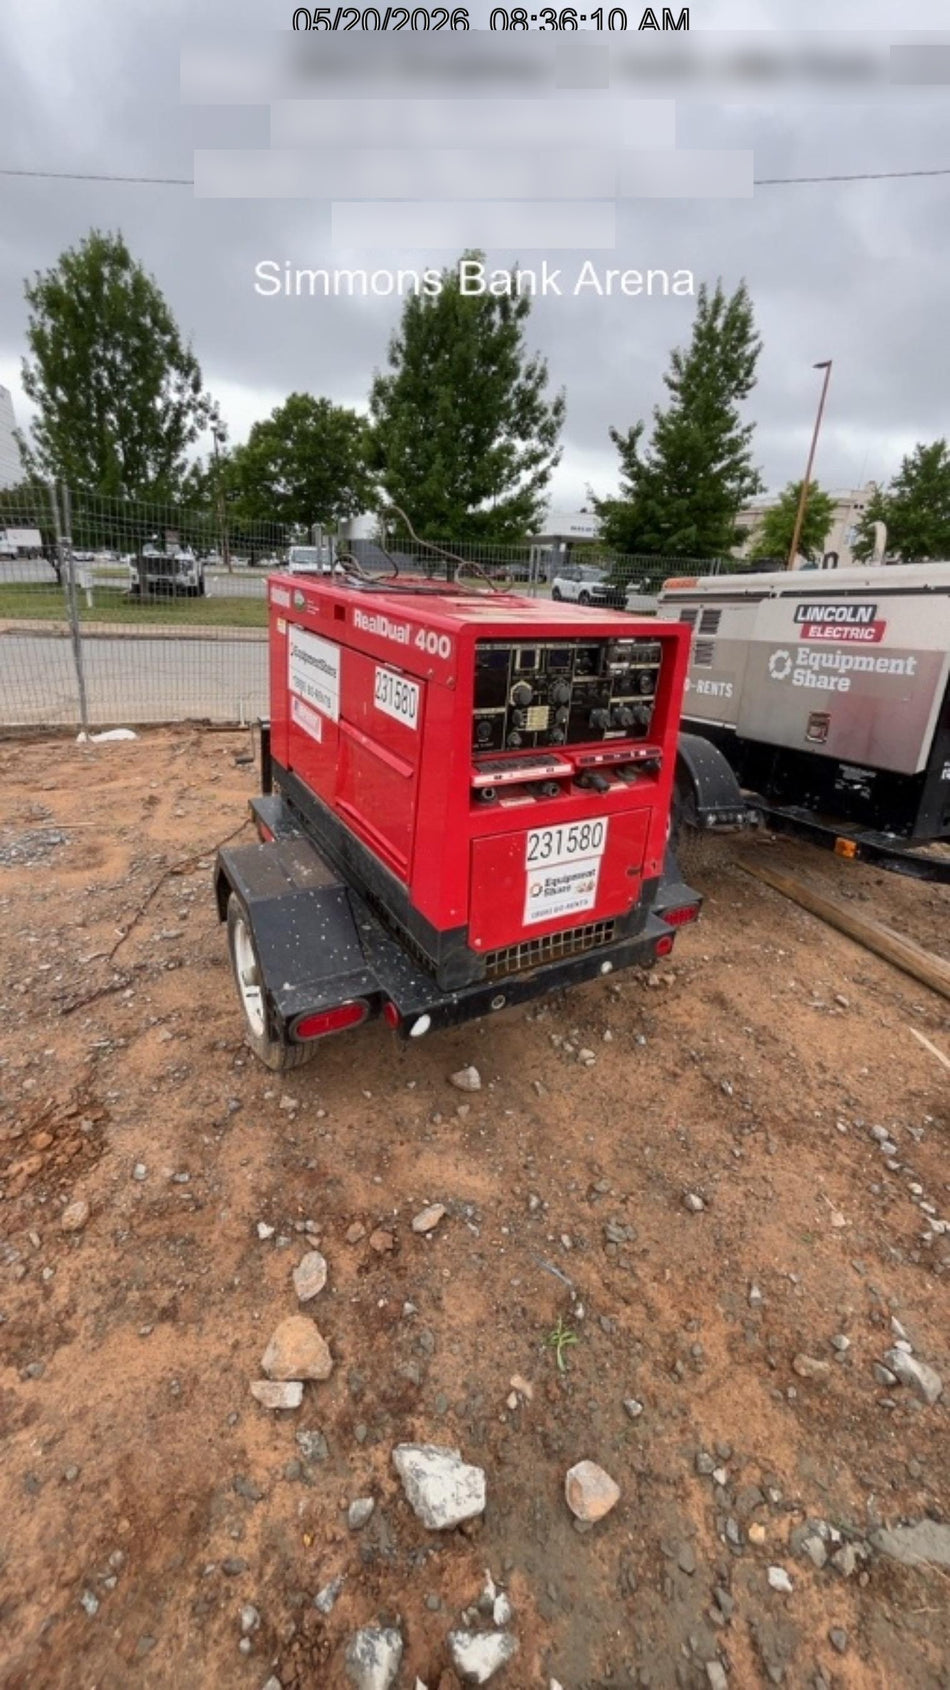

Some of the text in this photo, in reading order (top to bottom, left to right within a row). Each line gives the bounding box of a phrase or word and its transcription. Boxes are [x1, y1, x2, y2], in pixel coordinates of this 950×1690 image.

[797, 605, 873, 623] LINCOLN
[353, 607, 411, 645] RealDual
[415, 628, 451, 659] 400
[808, 625, 875, 640] ELECTRIC
[795, 647, 917, 676] Equipment
[792, 668, 851, 692] Share
[375, 671, 416, 719] 231580
[527, 822, 604, 862] 231580
[544, 868, 596, 888] Equipment
[543, 885, 572, 897] Share
